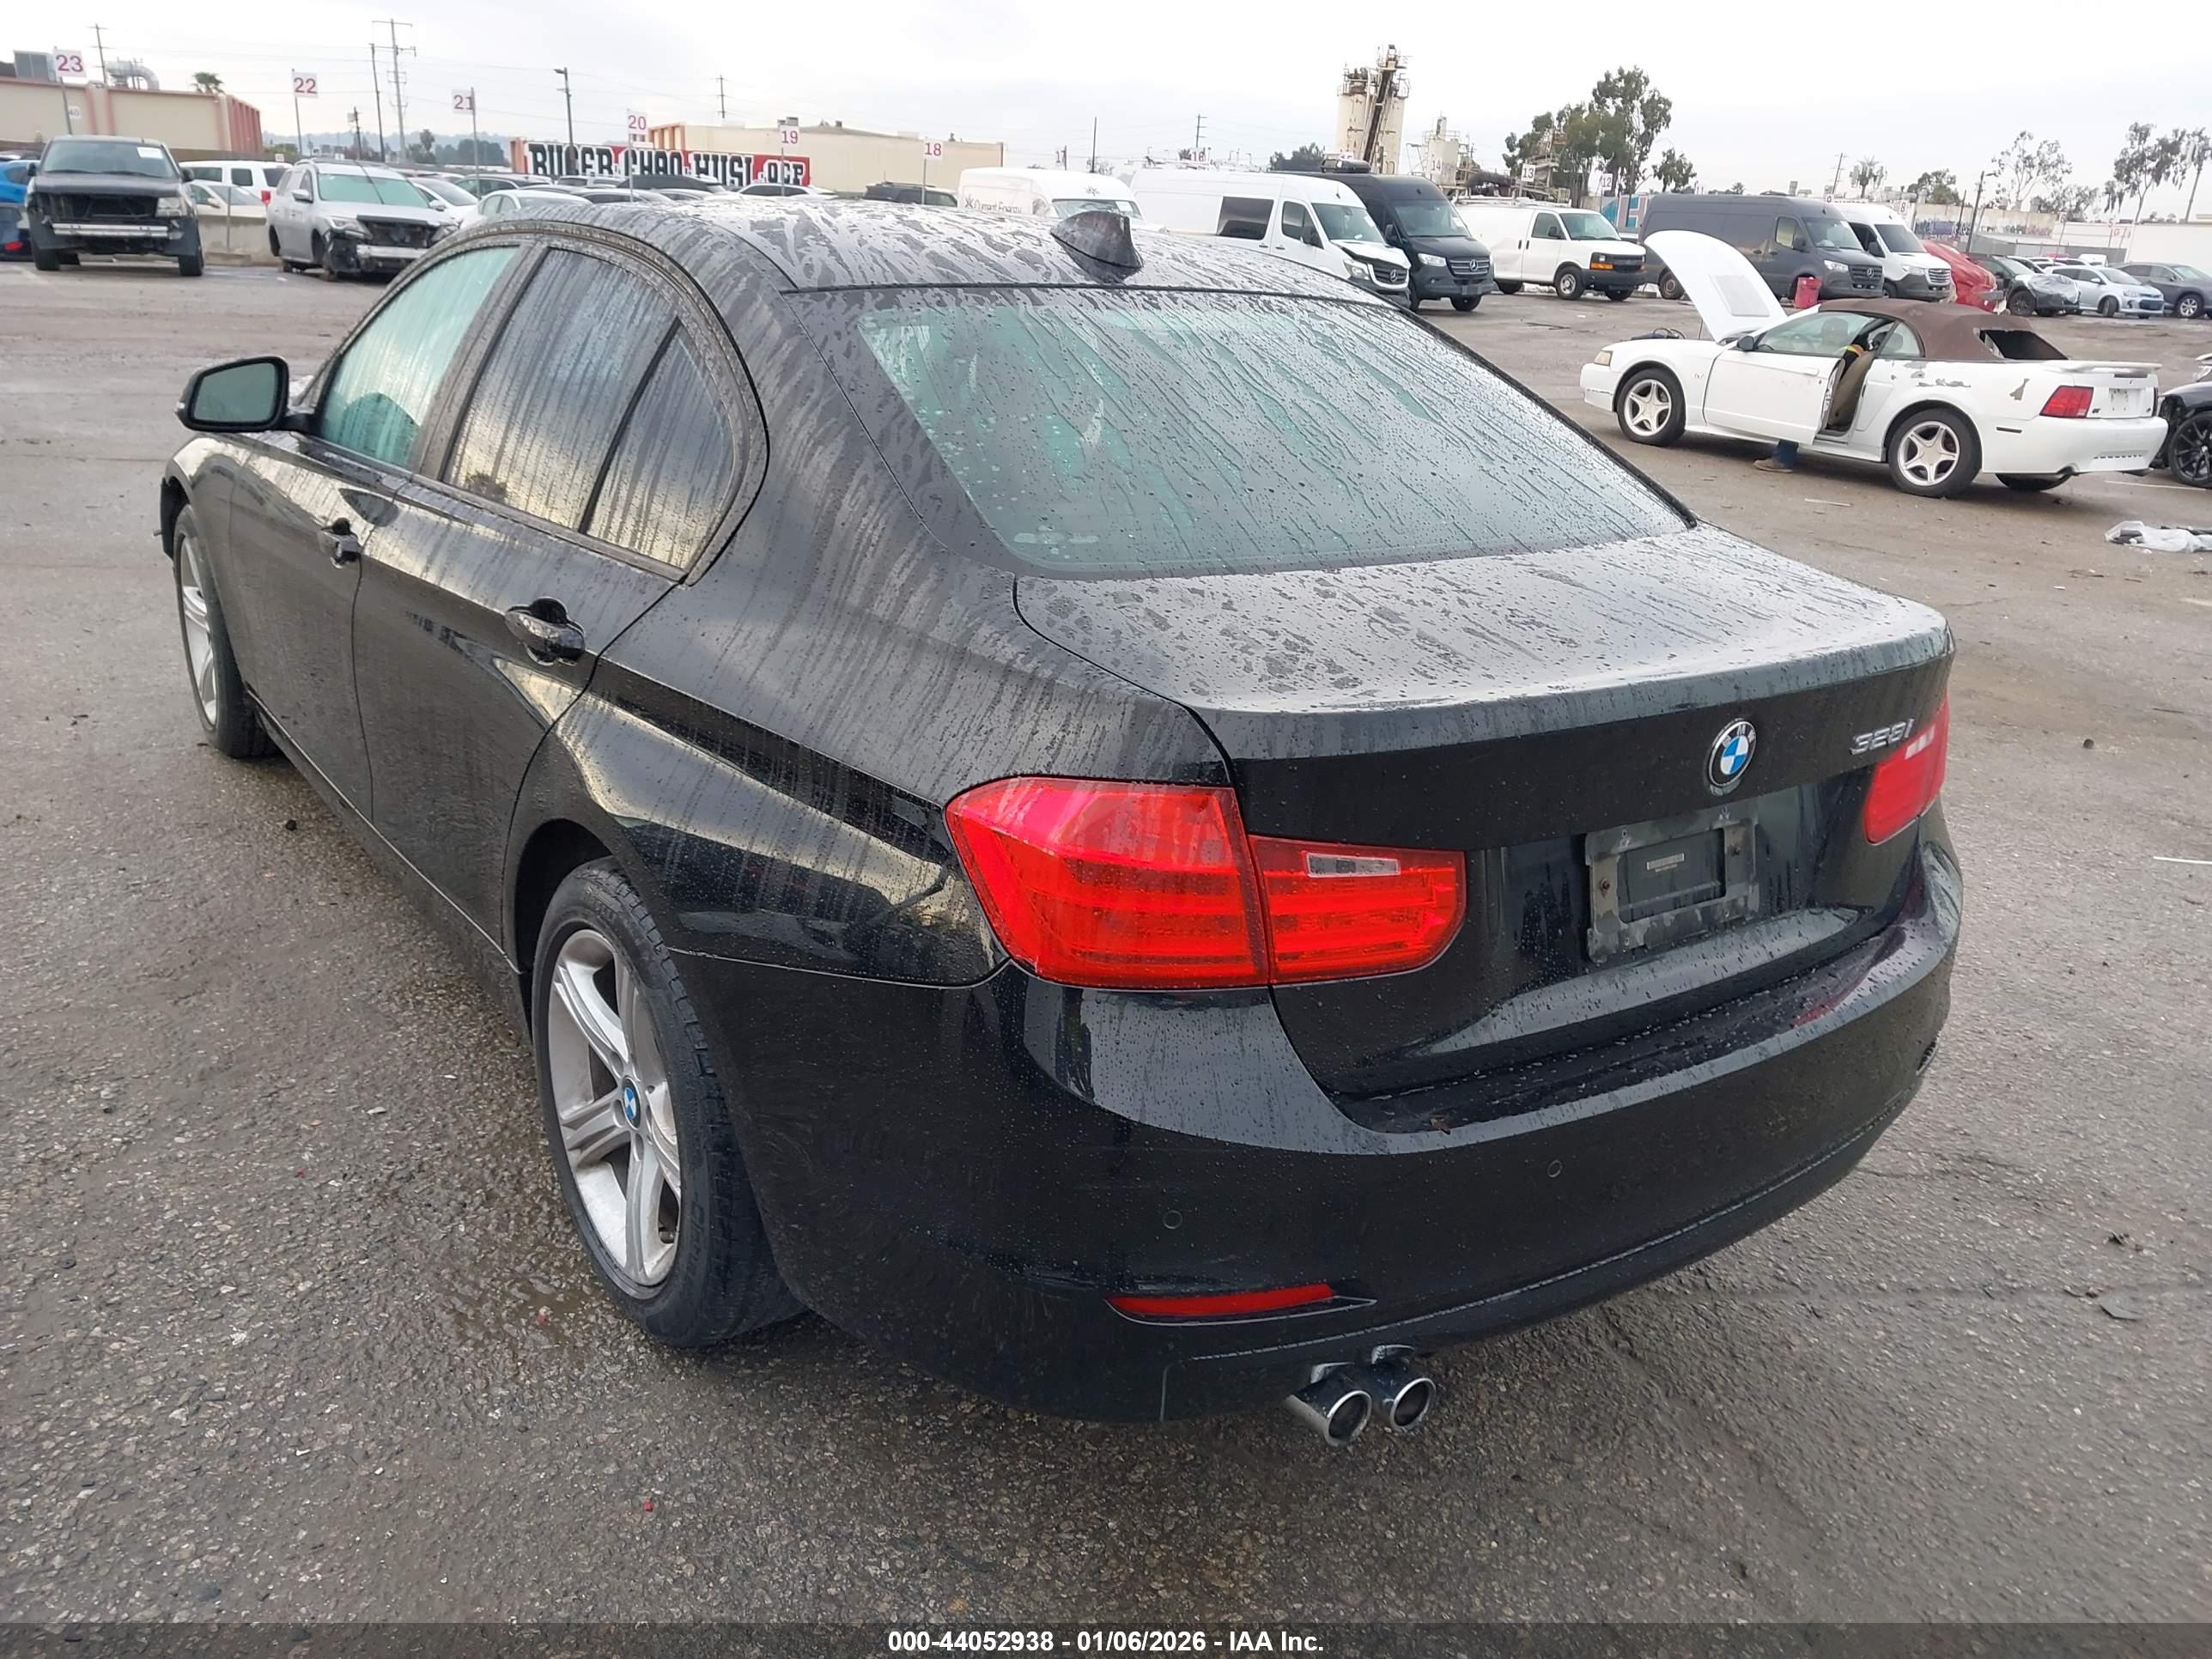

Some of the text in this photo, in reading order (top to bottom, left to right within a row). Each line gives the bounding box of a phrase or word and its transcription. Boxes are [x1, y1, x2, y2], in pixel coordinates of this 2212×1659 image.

[56, 54, 83, 72] 23
[294, 77, 317, 94] 22
[453, 94, 473, 110] 21
[628, 115, 647, 130] 20
[781, 131, 799, 143] 19
[924, 142, 942, 157] 18
[1431, 160, 1441, 171] 14
[1523, 167, 1534, 179] 13
[1602, 177, 1612, 187] 12
[1850, 718, 1916, 756] 328i
